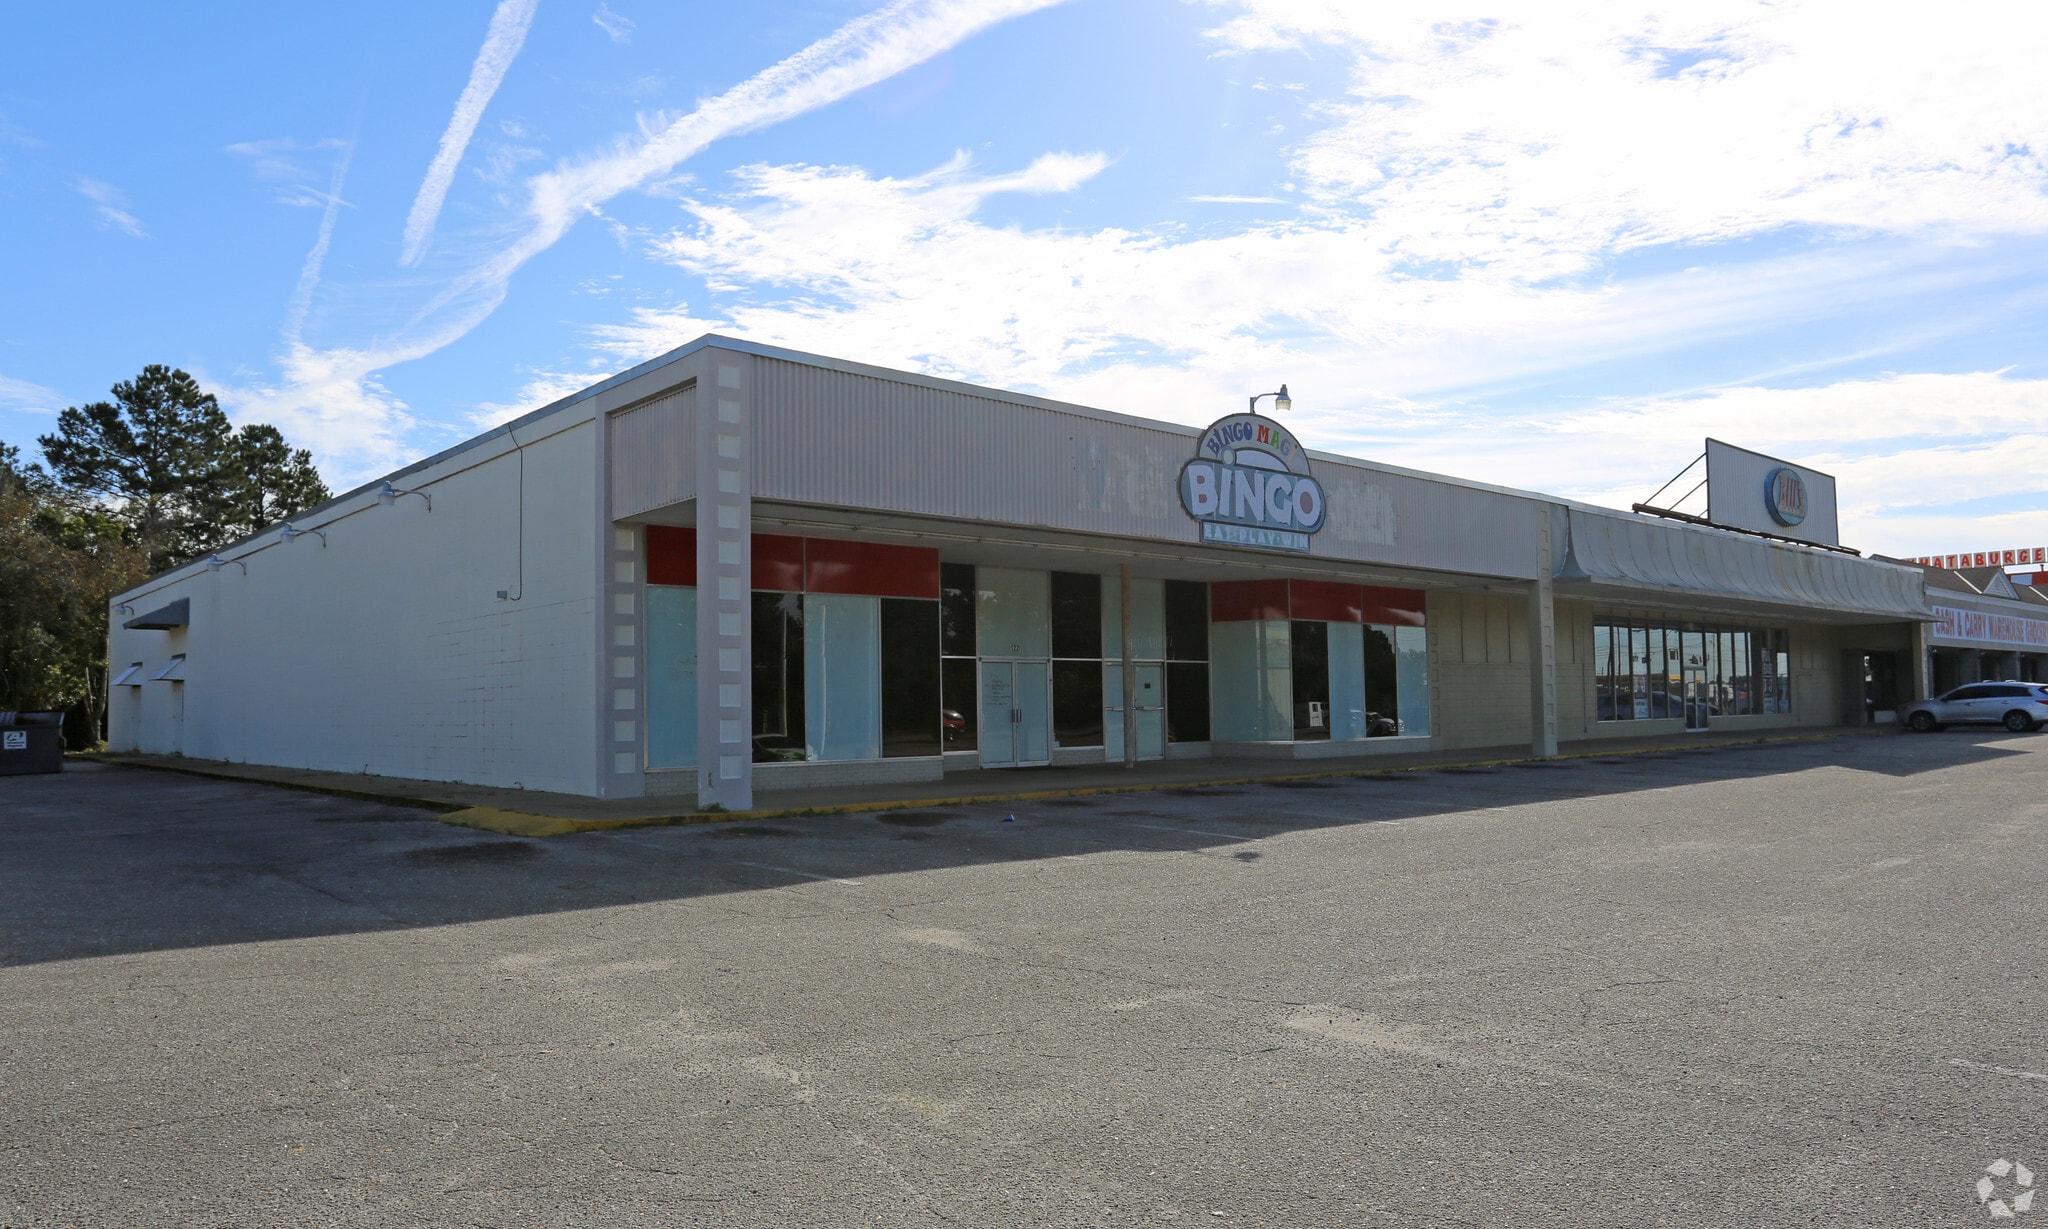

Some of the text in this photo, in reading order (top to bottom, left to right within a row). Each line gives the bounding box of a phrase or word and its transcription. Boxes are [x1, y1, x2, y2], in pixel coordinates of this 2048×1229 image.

[1207, 422, 1253, 457] BINGO
[1188, 463, 1321, 527] BINGO
[1239, 528, 1275, 544] PLAY
[1282, 533, 1308, 548] WIN
[1906, 549, 2042, 569] HATABURGE
[1958, 612, 1962, 636] &
[1964, 612, 1986, 640] CARRY
[1989, 616, 2024, 642] WAREHOUSE
